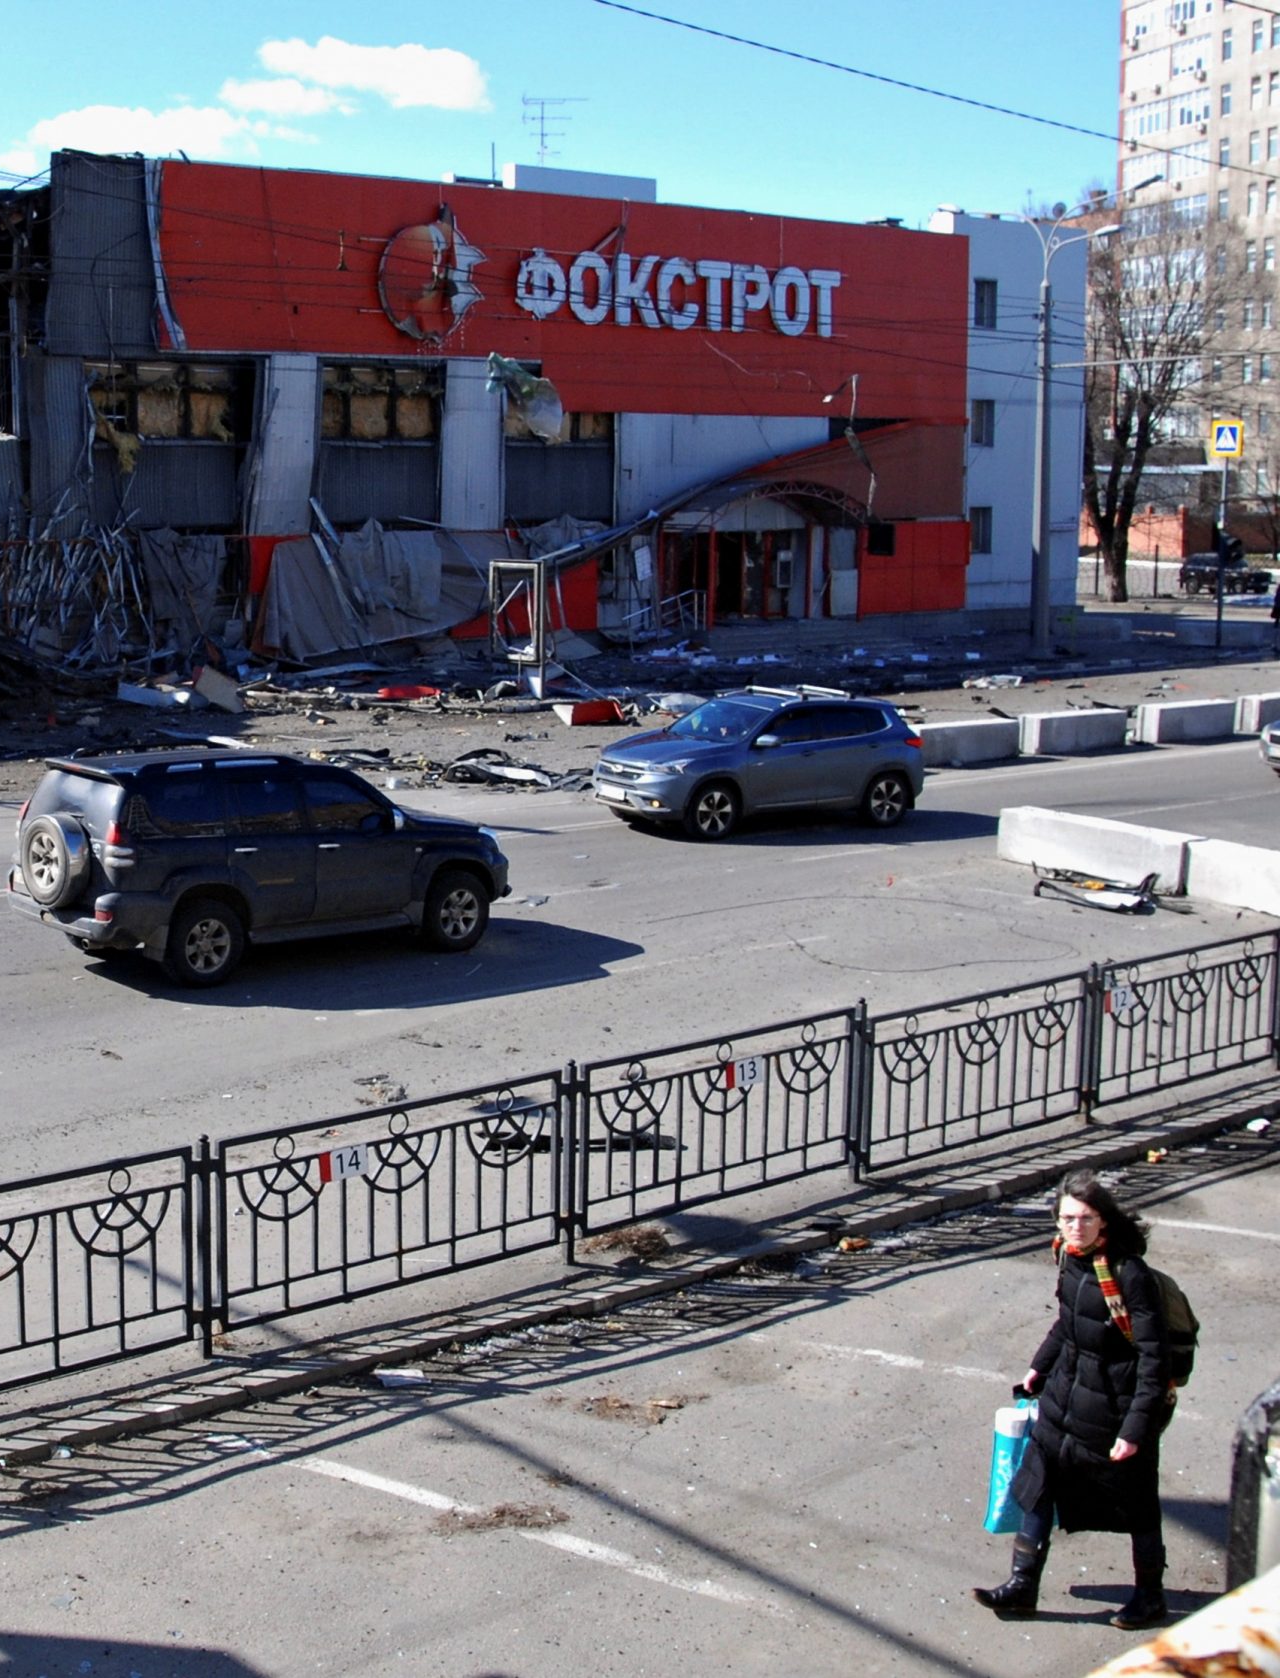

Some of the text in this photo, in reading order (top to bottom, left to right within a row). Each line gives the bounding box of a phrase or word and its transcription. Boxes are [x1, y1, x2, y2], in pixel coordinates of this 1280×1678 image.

[515, 247, 841, 338] ФОКСТРОТ
[1114, 990, 1127, 1009] 12
[739, 1060, 757, 1082] 13
[336, 1150, 361, 1174] 14
